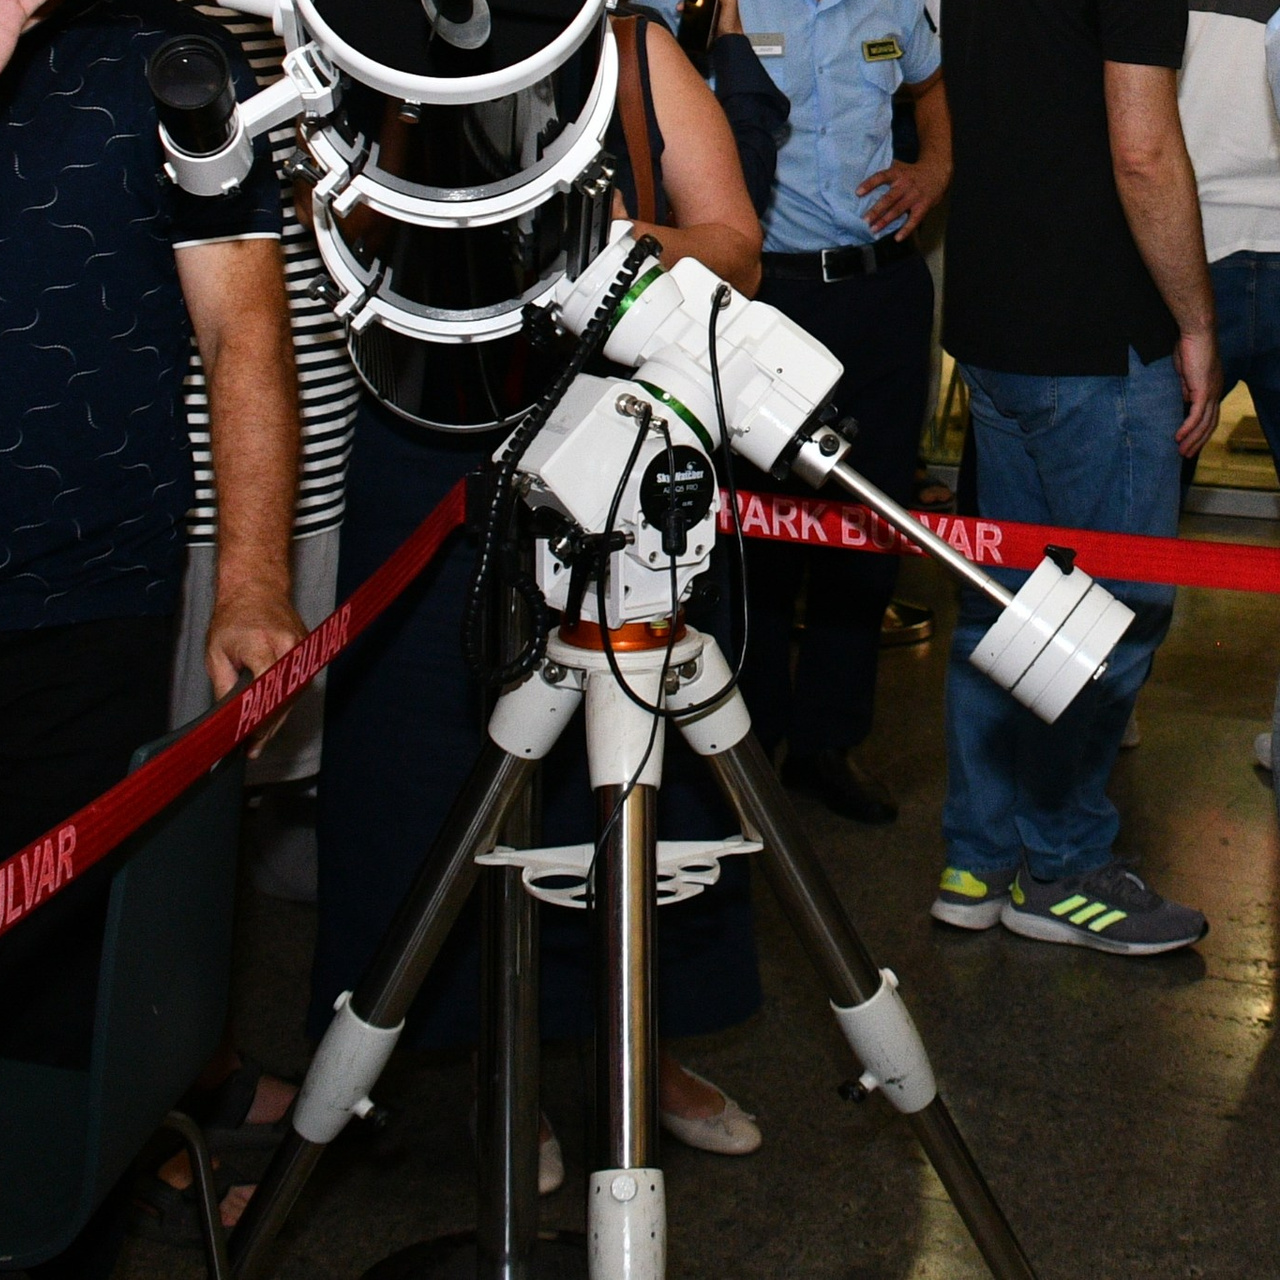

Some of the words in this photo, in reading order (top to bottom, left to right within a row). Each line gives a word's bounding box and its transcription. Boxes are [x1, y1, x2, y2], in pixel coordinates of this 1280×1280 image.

[719, 490, 829, 543] PARK
[234, 656, 290, 742] PARK
[287, 602, 352, 696] BULVAR
